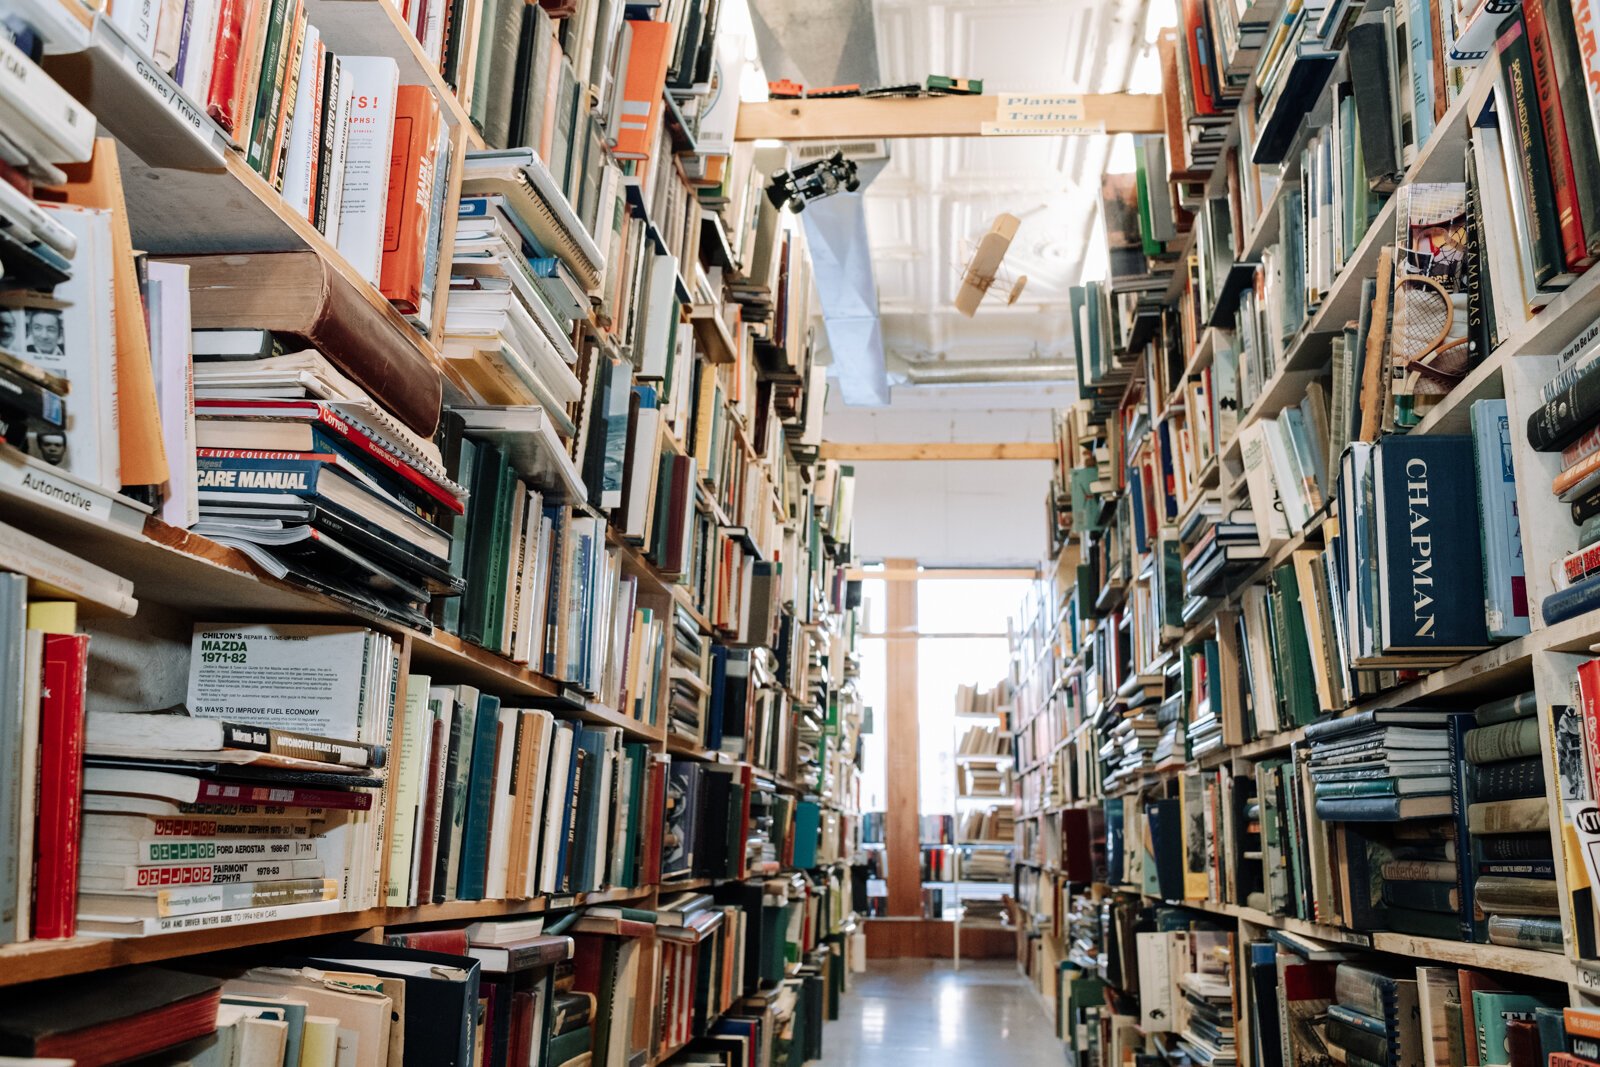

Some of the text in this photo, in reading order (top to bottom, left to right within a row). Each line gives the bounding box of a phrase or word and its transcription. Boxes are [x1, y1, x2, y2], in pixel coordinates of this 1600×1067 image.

[1511, 58, 1524, 100] SPORTS
[137, 61, 168, 99] Games
[176, 97, 201, 128] Trivia
[286, 79, 296, 117] ODDS
[352, 96, 378, 109] S!
[1007, 97, 1077, 106] Planes
[1009, 112, 1078, 120] Trains
[1517, 99, 1532, 150] MEDICINE
[426, 225, 436, 274] NATION
[1466, 188, 1481, 327] PETE SAMPRAS
[1562, 347, 1574, 363] How
[1579, 337, 1589, 352] Be
[1588, 327, 1599, 345] Like
[323, 411, 349, 436] Corvette
[208, 450, 235, 459] AUTO
[241, 451, 301, 460] COLLECTION
[197, 471, 309, 490] CARE MANUAL
[21, 473, 92, 512] Automotive
[1406, 457, 1435, 639] CHAPMAN
[201, 641, 247, 652] MAZDA
[202, 632, 242, 640] CHILTON'S
[201, 652, 247, 663] 1971-82
[386, 657, 399, 741] CHILTON
[285, 708, 320, 716] ECONOMY
[277, 736, 314, 750] AUTOMOTIVE
[314, 741, 331, 752] BRAKE
[573, 767, 581, 792] HEREDITY
[155, 819, 217, 836] CHILTON
[217, 825, 246, 834] FAIRMONT
[248, 825, 270, 834] ZEPHYR
[150, 842, 312, 860] CHILTON FORD AEROSTAR 1986-87 7747
[137, 864, 280, 886] CHILTON FAIRMONT 1978-83
[212, 873, 241, 883] ZEPHYR
[161, 921, 171, 930] CAR
[173, 919, 182, 928] AND
[184, 918, 200, 927] DRIVER
[202, 916, 219, 926] BUYERS
[220, 915, 233, 924] GUIDE
[252, 911, 264, 920] NEW
[264, 909, 277, 919] CARS
[1573, 1039, 1598, 1060] LONG
